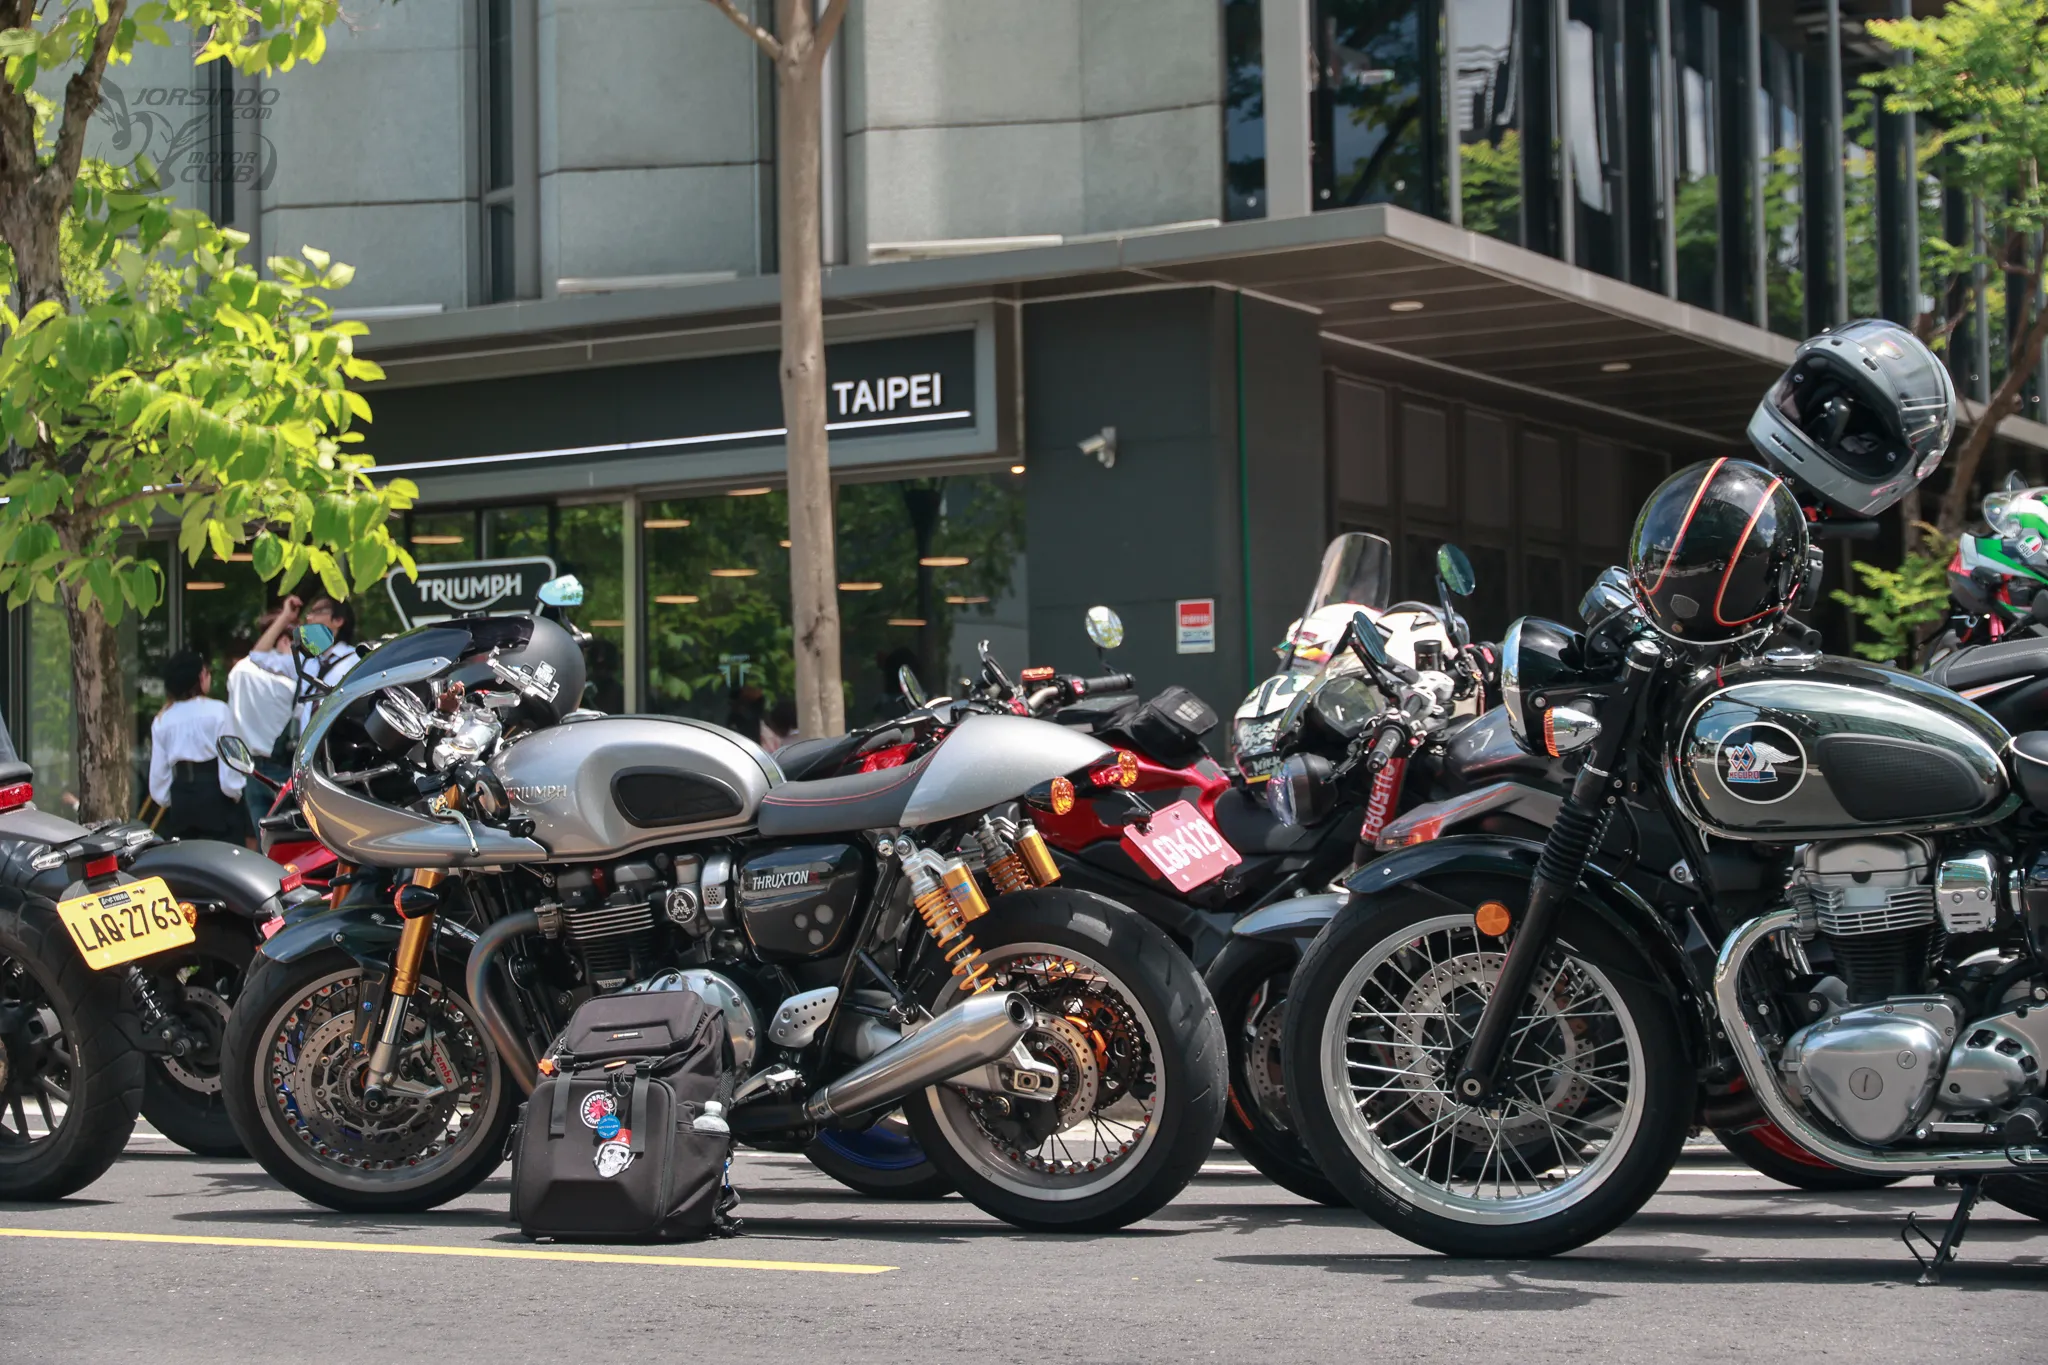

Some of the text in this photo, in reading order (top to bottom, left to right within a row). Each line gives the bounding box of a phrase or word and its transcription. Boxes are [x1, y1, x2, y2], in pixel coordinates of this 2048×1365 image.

[832, 372, 941, 415] TAIPEI
[417, 573, 522, 610] TRIUMPH
[1729, 770, 1760, 779] MEGURO
[505, 785, 567, 804] TRIUMPH
[1142, 818, 1222, 875] LGD-6129
[753, 870, 809, 890] THRUXTON
